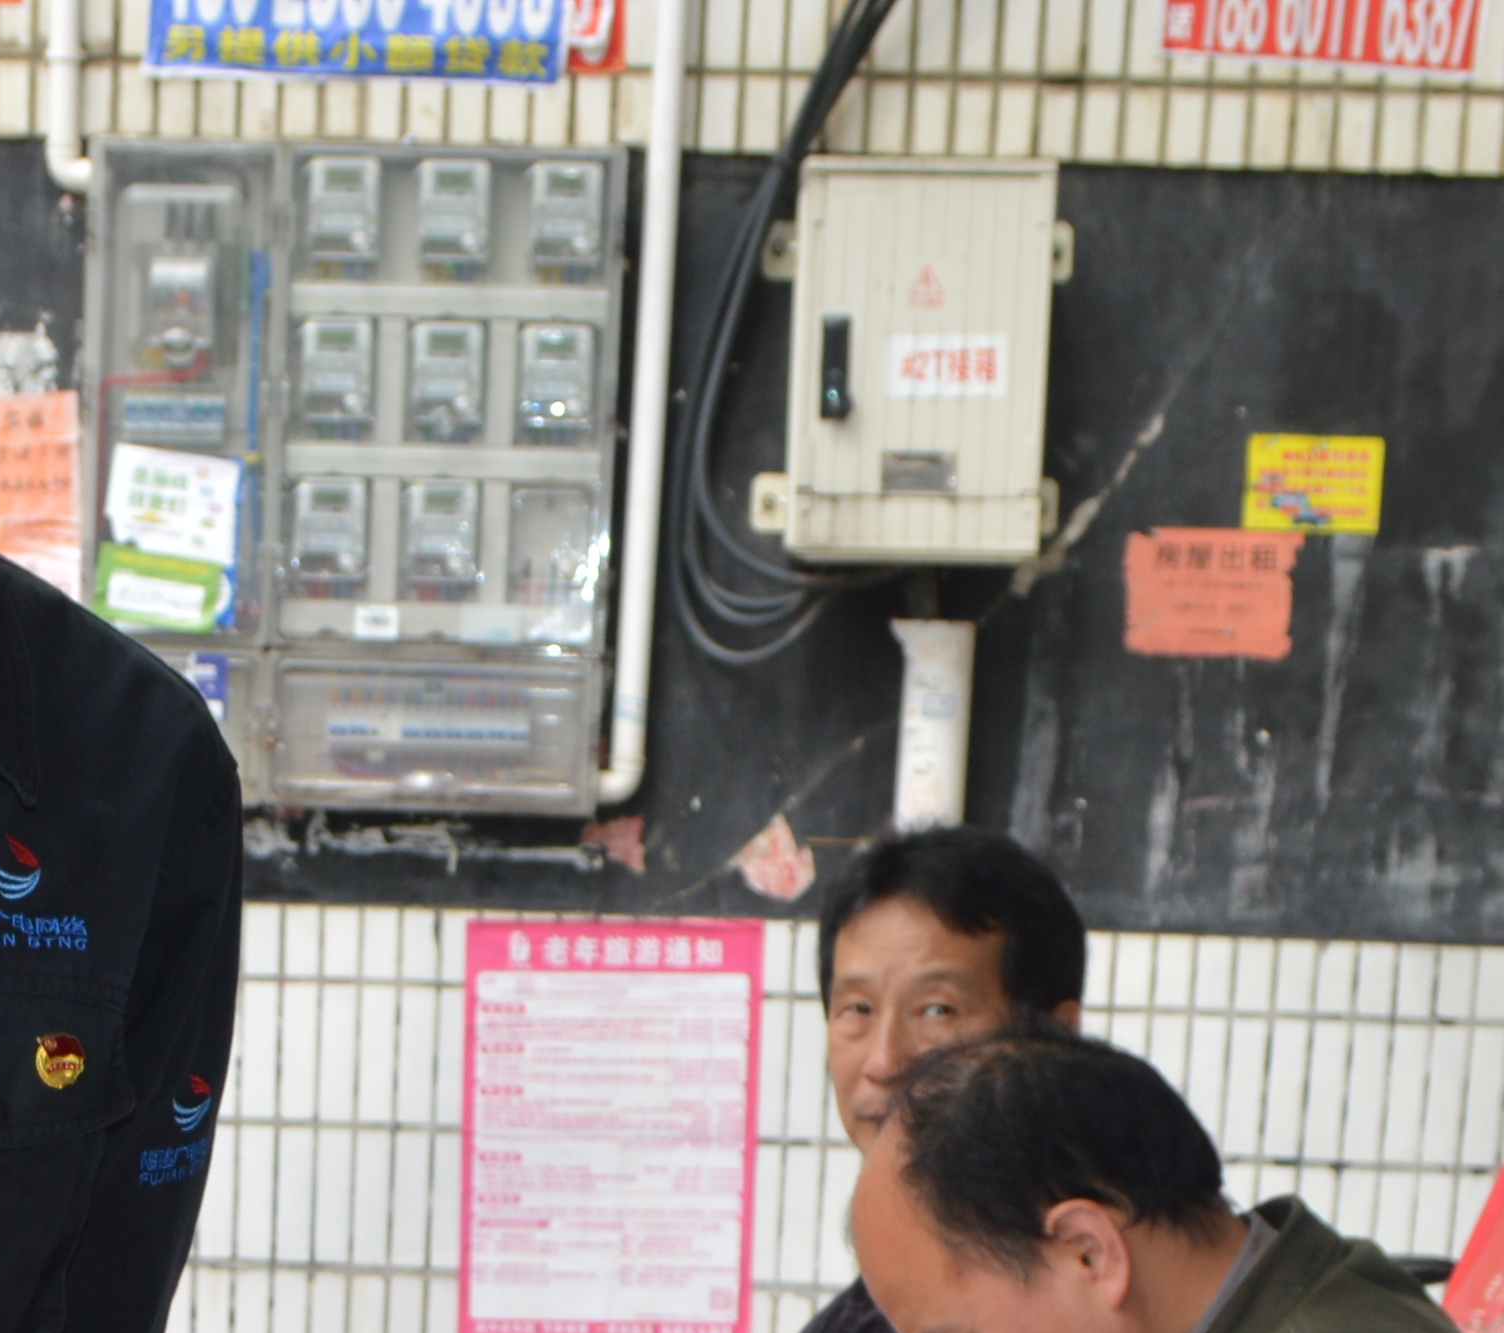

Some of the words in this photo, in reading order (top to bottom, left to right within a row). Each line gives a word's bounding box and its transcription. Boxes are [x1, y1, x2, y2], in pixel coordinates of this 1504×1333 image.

[544, 934, 723, 968] 老年旅游通知
